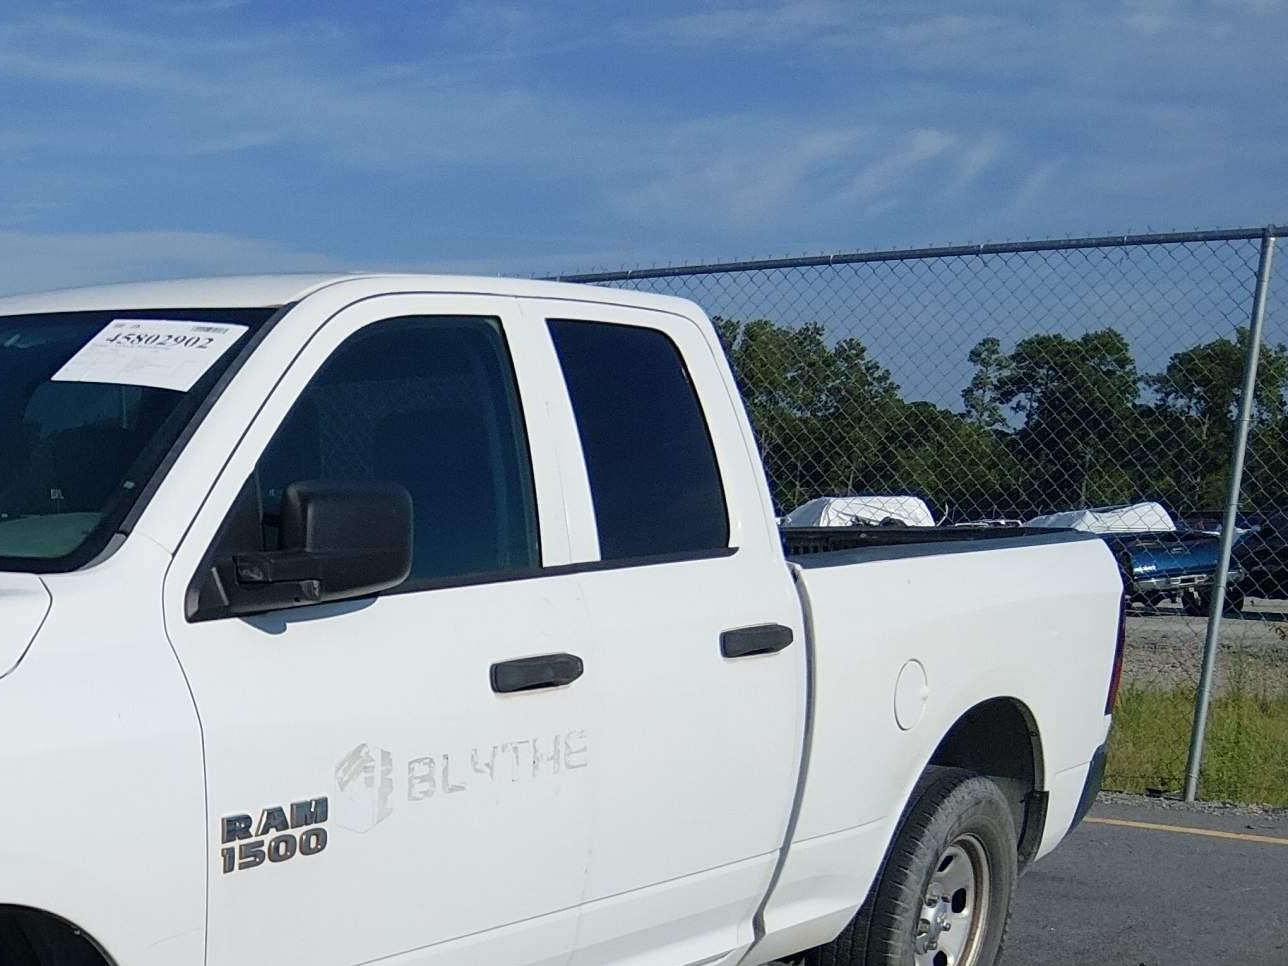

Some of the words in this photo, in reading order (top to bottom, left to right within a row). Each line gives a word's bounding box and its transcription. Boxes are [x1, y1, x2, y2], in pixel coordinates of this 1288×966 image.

[106, 333, 214, 349] 45802902
[408, 730, 587, 801] BLYTHE
[221, 796, 328, 844] RAM
[221, 827, 328, 874] 1500
